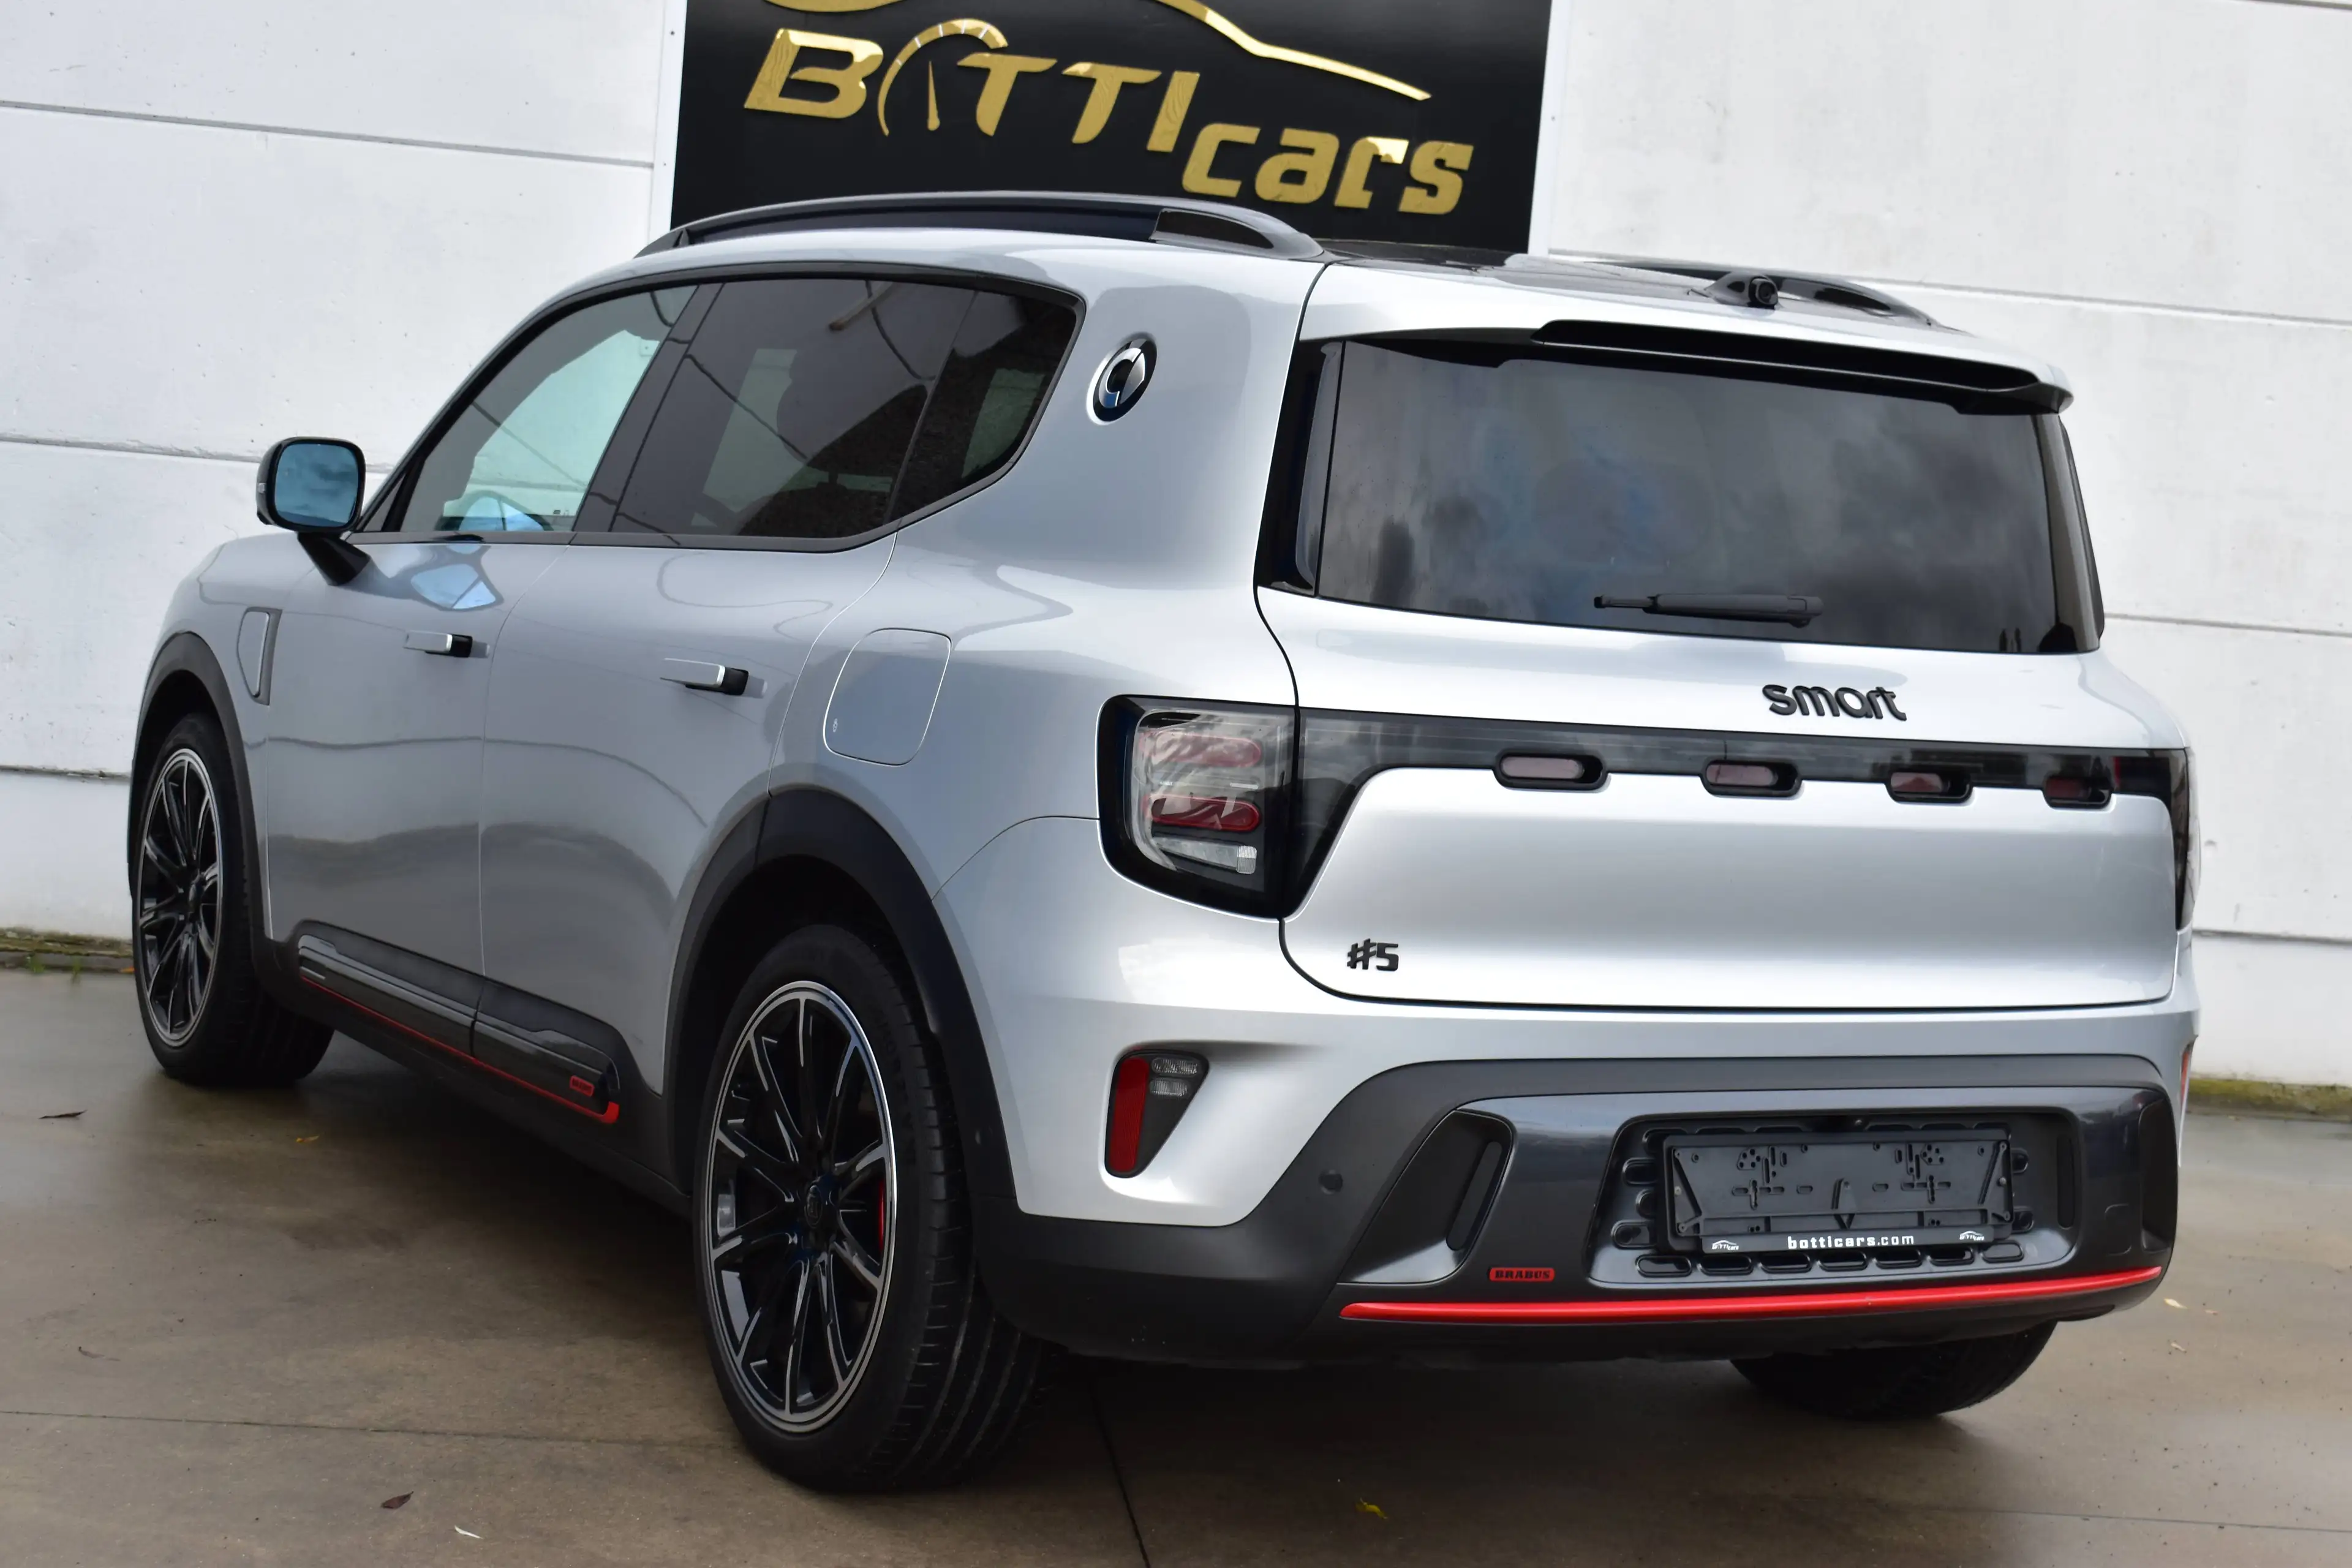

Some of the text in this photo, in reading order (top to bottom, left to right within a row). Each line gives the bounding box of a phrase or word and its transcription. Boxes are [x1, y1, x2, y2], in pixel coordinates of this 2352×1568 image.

[1182, 122, 1474, 215] cars
[1762, 684, 1907, 722] smart
[1346, 938, 1399, 971] #5
[1787, 1235, 1914, 1250] botticars.com
[1494, 1270, 1550, 1280] BRABUS
